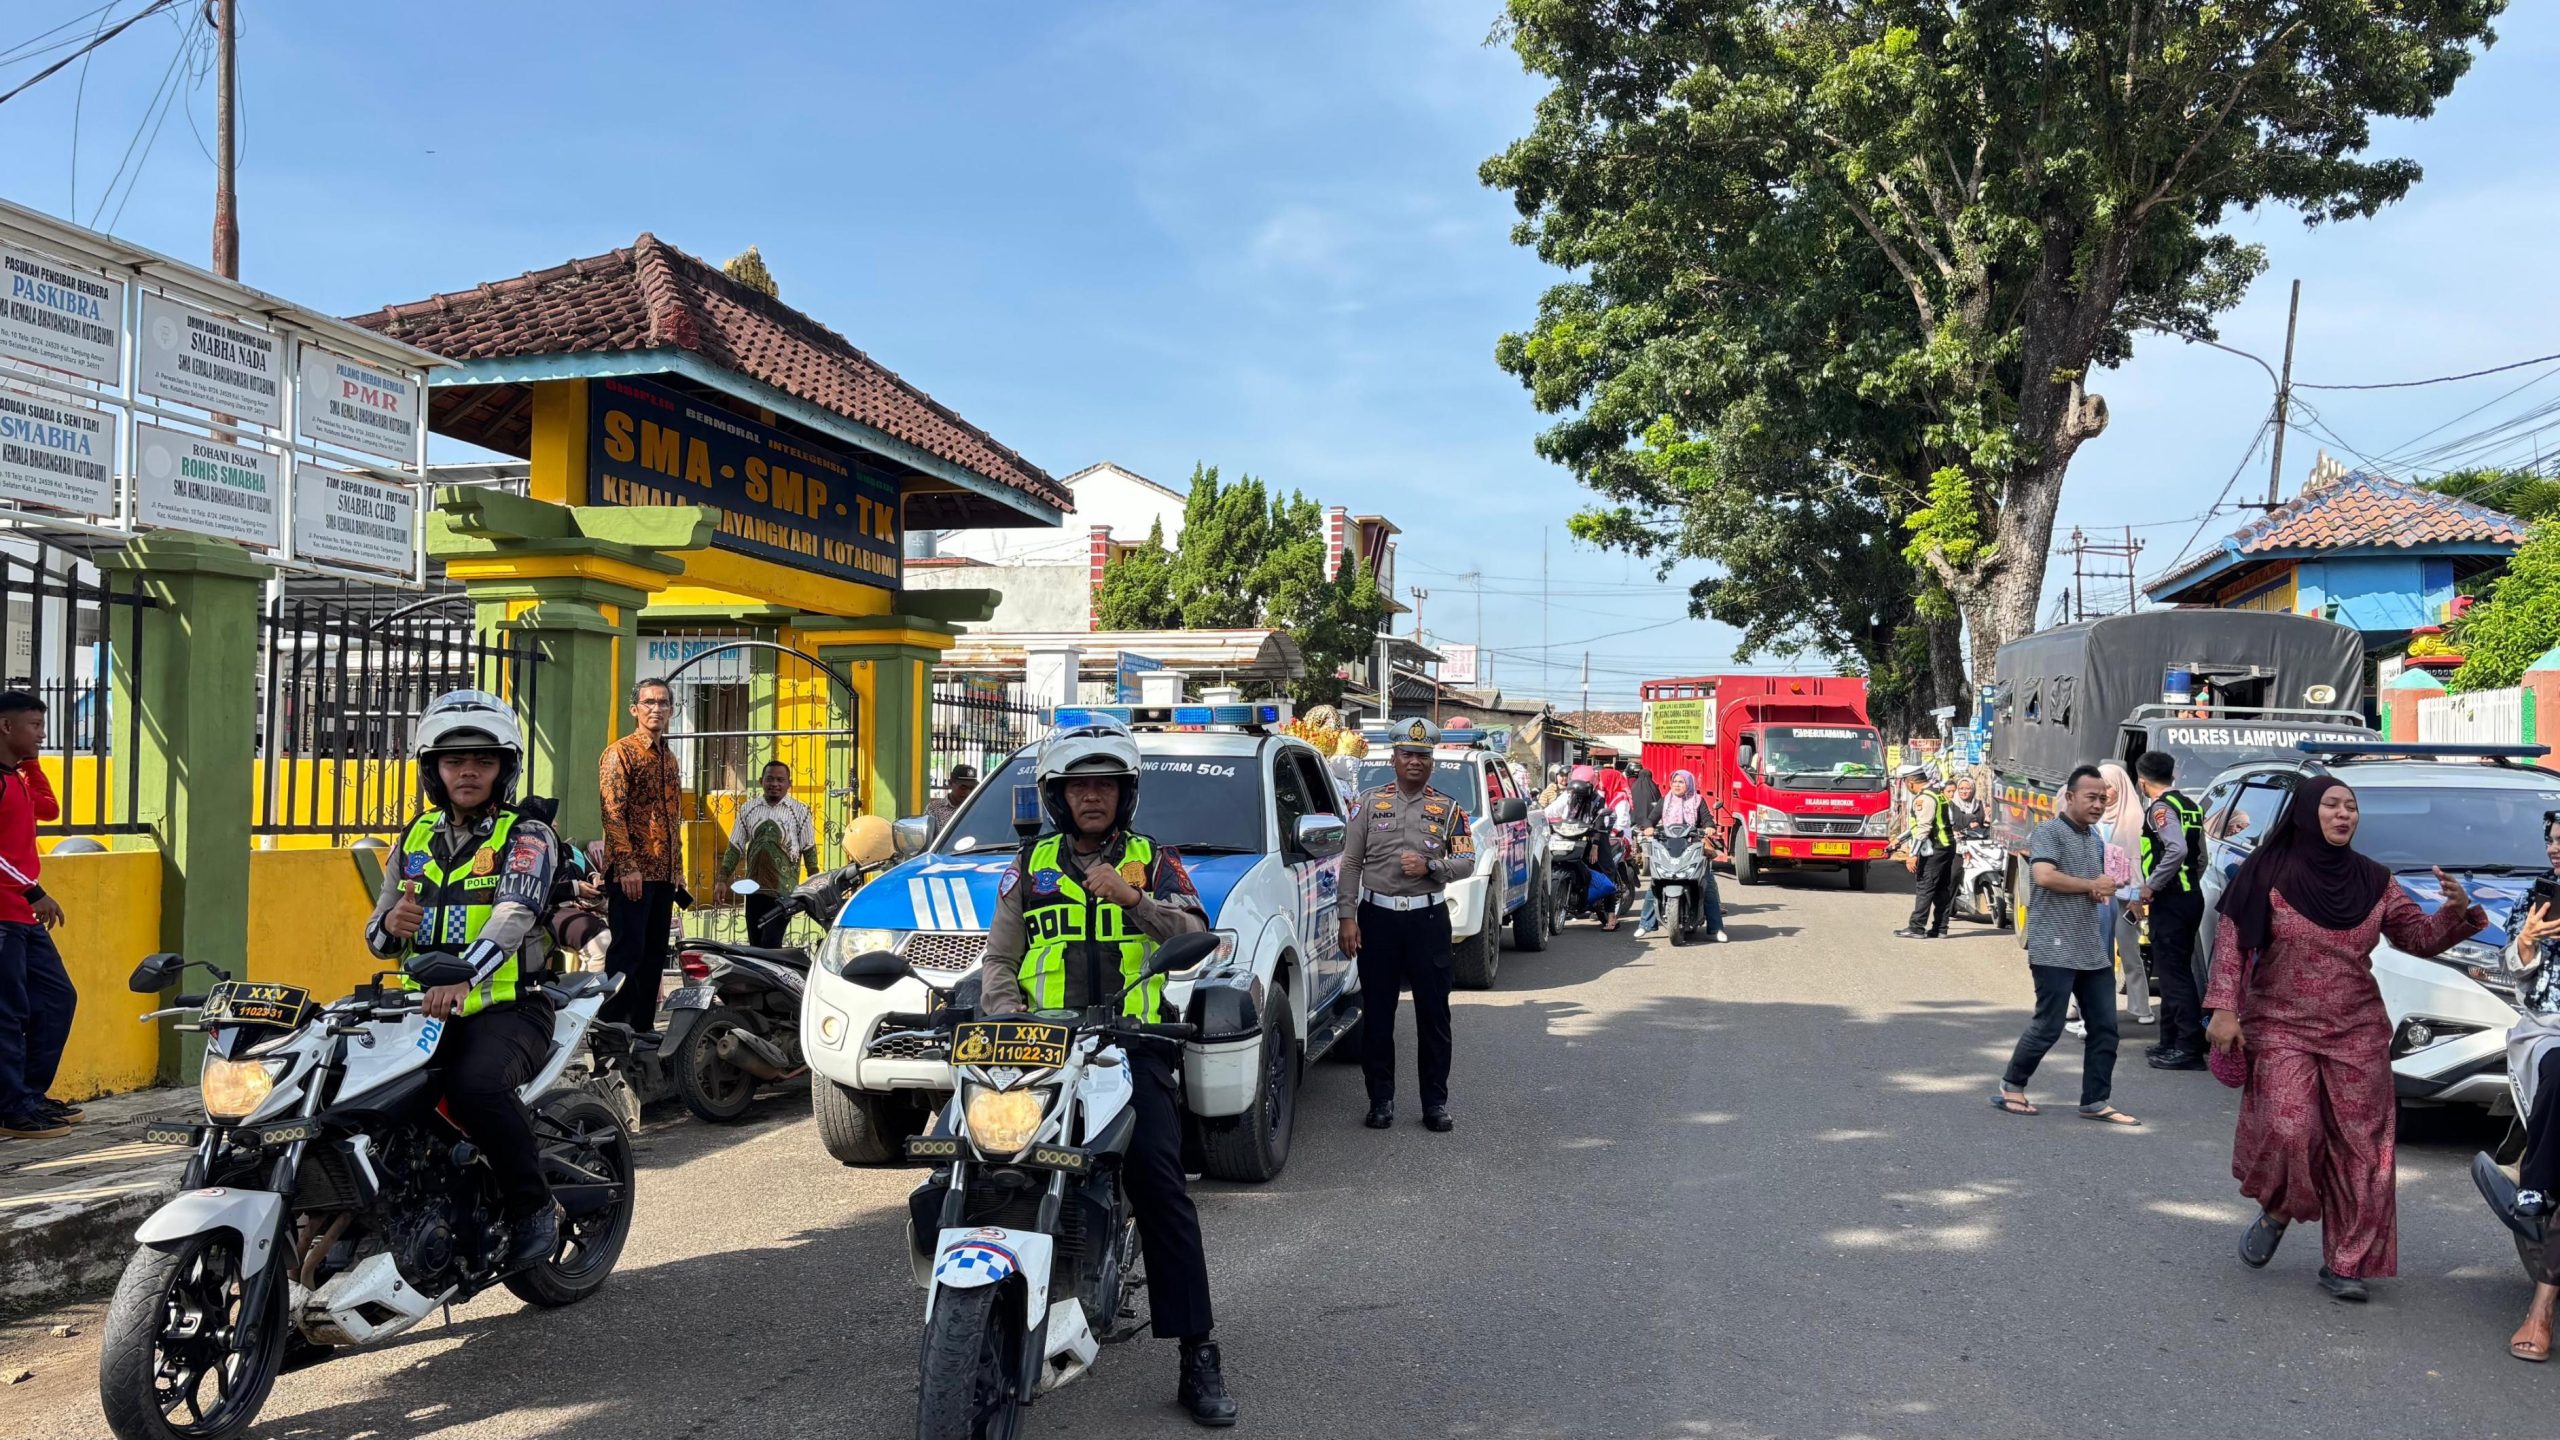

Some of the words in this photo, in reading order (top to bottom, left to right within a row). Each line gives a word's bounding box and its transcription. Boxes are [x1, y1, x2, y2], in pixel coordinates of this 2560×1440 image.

[5, 256, 39, 280] PASUKAN
[41, 268, 75, 290] PENGIBAR
[78, 280, 108, 300] BENDERA
[0, 298, 8, 318] MA
[11, 302, 36, 325] KEMALA
[38, 309, 80, 338] BHAYANGKARI
[82, 322, 114, 347] KOTABUMI
[187, 316, 204, 331] DRUM
[206, 322, 220, 336] BAND
[221, 327, 225, 337] &
[227, 328, 256, 347] MARCHING
[257, 338, 271, 352] BAND
[191, 332, 235, 362] SMABHA
[239, 346, 266, 371] NADA
[178, 354, 190, 372] SMA
[192, 358, 212, 379] KEMALA
[250, 376, 275, 397] KOTABUMI
[337, 364, 359, 380] PALANG
[361, 371, 381, 387] MERAH
[383, 379, 405, 395] REMAJA
[343, 380, 398, 413] PMR
[0, 398, 26, 415] ADUAN
[28, 405, 55, 422] SUARA
[57, 412, 62, 423] &
[64, 414, 80, 428] SENI
[83, 418, 99, 433] TARI
[0, 416, 92, 456] SMABHA
[686, 407, 761, 444] BERMORAL
[768, 439, 848, 477] INTELEGENSIA
[3, 443, 28, 466] KEMALA
[30, 449, 73, 476] BHAYANGKARI
[74, 459, 106, 483] KOTABUMI
[193, 444, 228, 463] ROHANI
[231, 453, 257, 469] ISLAM
[174, 479, 186, 497] SMA
[189, 482, 209, 502] KEMALA
[182, 457, 217, 481] ROHIS
[221, 466, 266, 493] SMABHA
[604, 409, 712, 489] SMA
[745, 456, 827, 520] SMP
[856, 495, 896, 545] TK
[326, 477, 339, 488] TIM
[341, 481, 362, 495] SEPAK
[364, 486, 381, 499] BOLA
[386, 491, 409, 505] FUTSAL
[338, 495, 373, 518] SMABHA
[375, 503, 396, 522] CLUB
[823, 537, 897, 580] KOTABUMI
[649, 641, 679, 660] POS
[2168, 728, 2230, 745] POLRES
[1160, 762, 1193, 772] UTARA
[1196, 764, 1235, 777] 504
[1440, 761, 1461, 770] 502
[1371, 811, 1395, 819] ANDI
[1421, 814, 1445, 825] POLRI
[400, 881, 421, 891] RFI
[497, 873, 546, 908] ATWA
[248, 987, 289, 1000] XXV
[1015, 1026, 1051, 1041] XXV
[998, 1046, 1061, 1063] 11022-31
